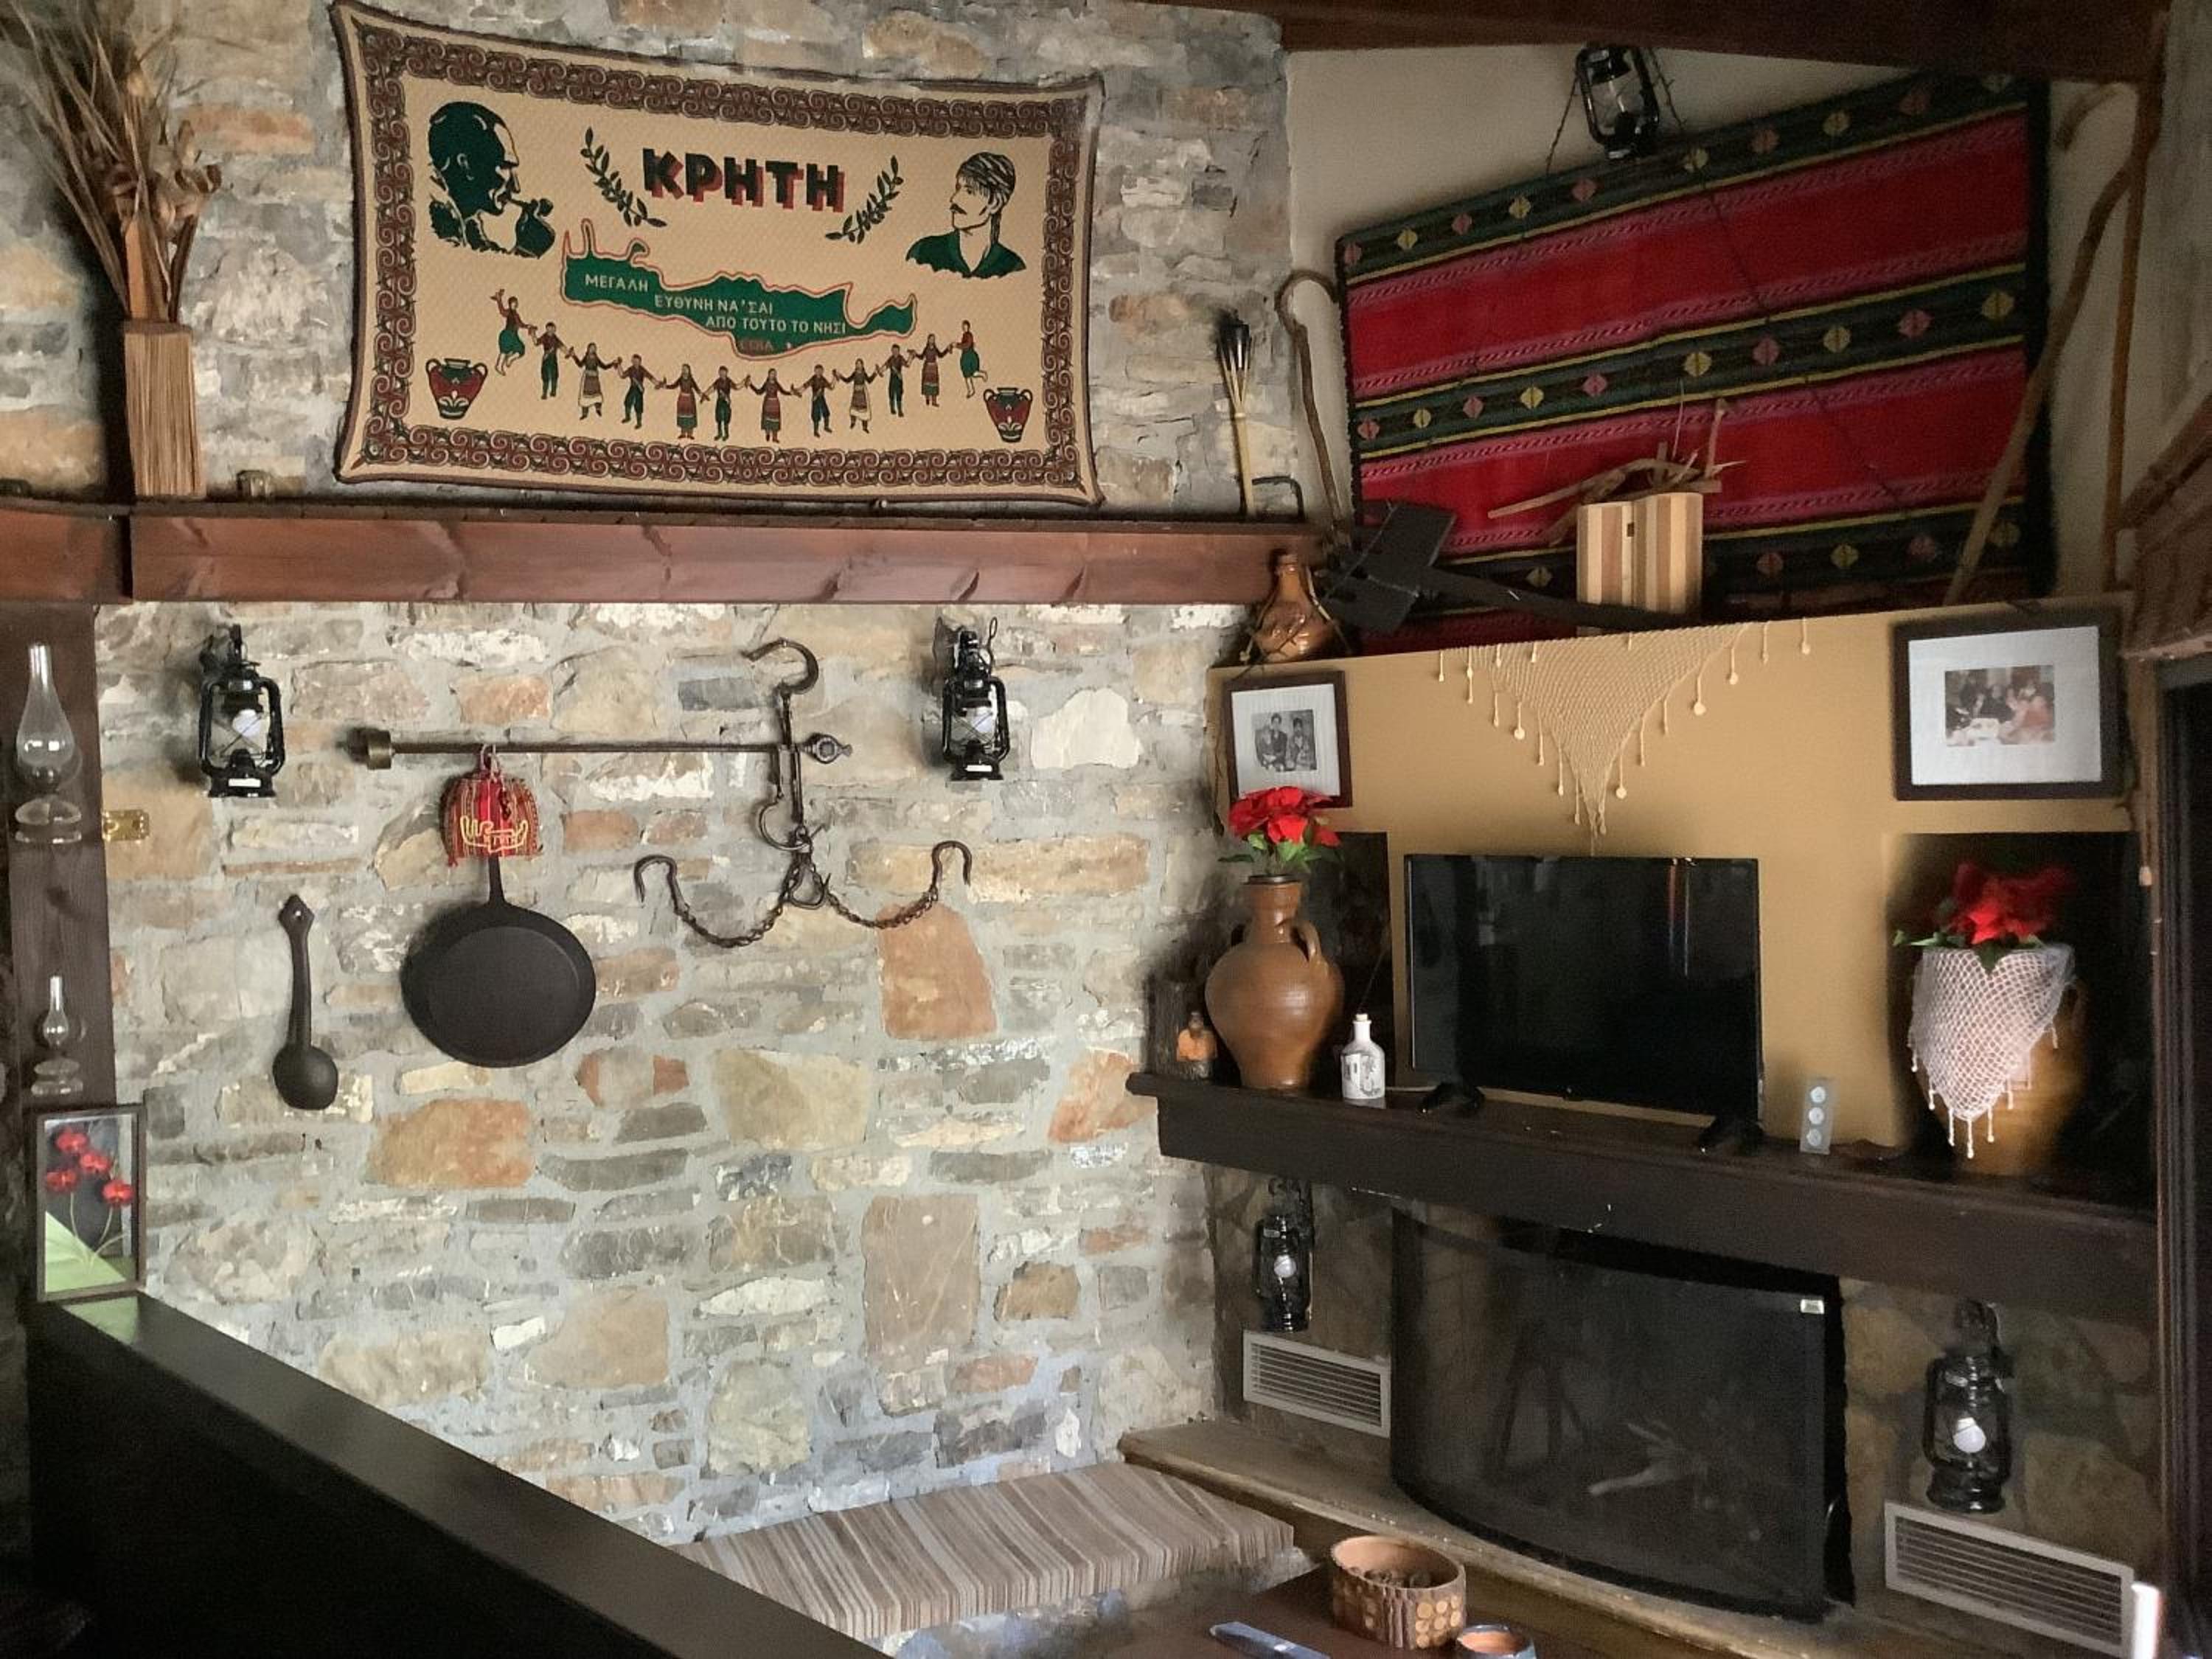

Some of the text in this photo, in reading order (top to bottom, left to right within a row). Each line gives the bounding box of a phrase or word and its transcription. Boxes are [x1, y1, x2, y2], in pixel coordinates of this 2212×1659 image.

[642, 147, 845, 213] ΚΡΗΤΗ
[585, 274, 648, 293] ΜΕΓΑΛΗ
[654, 294, 713, 311] ΕΥΘΥΝΗ
[706, 316, 846, 335] ΑΠΟ ΤΟΥΤΟ ΤΟ ΝΗΣΙ
